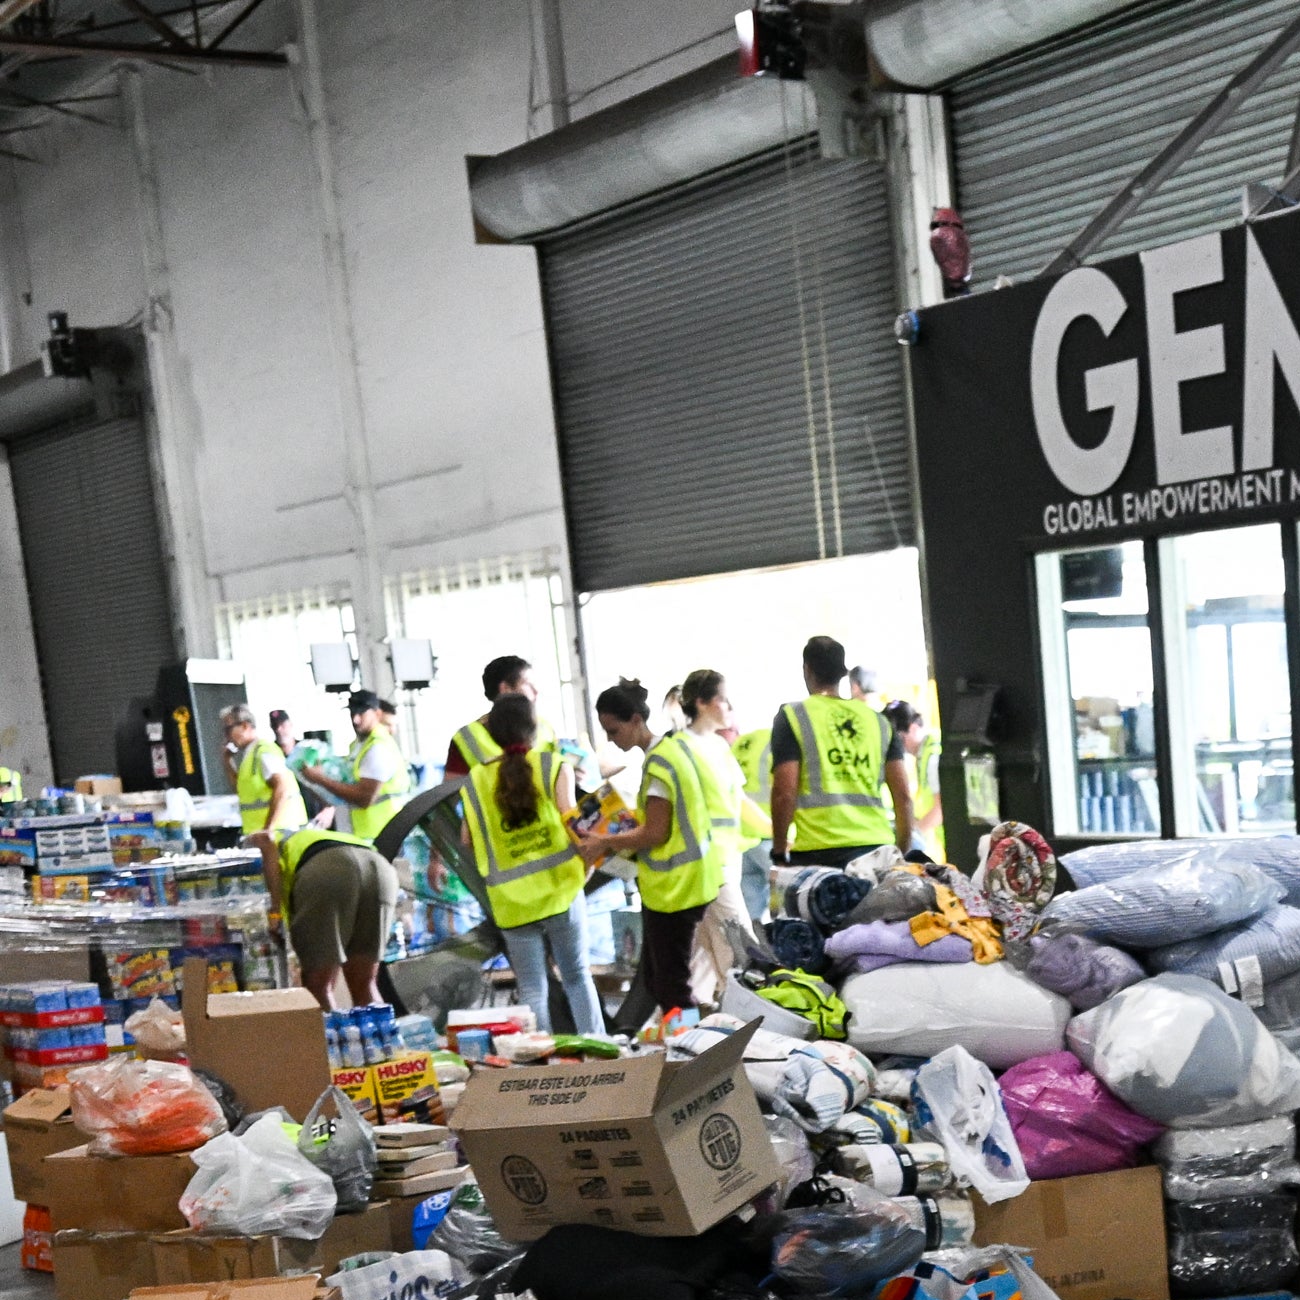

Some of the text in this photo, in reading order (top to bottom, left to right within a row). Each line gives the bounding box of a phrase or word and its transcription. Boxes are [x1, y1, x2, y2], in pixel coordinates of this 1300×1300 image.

[1042, 492, 1119, 536] GLOBAL
[1122, 469, 1284, 525] EMPOWERMENT
[378, 1058, 428, 1080] HUSKY
[499, 1071, 625, 1093] ESTIBAR ESTE LADO ARRIBA
[528, 1091, 587, 1105] THIS SIDE UP
[671, 1078, 735, 1126] 24 PAETES
[559, 1127, 632, 1144] 24 PAQUETES
[1060, 1273, 1072, 1286] IN
[1073, 1268, 1105, 1284] CHINA
